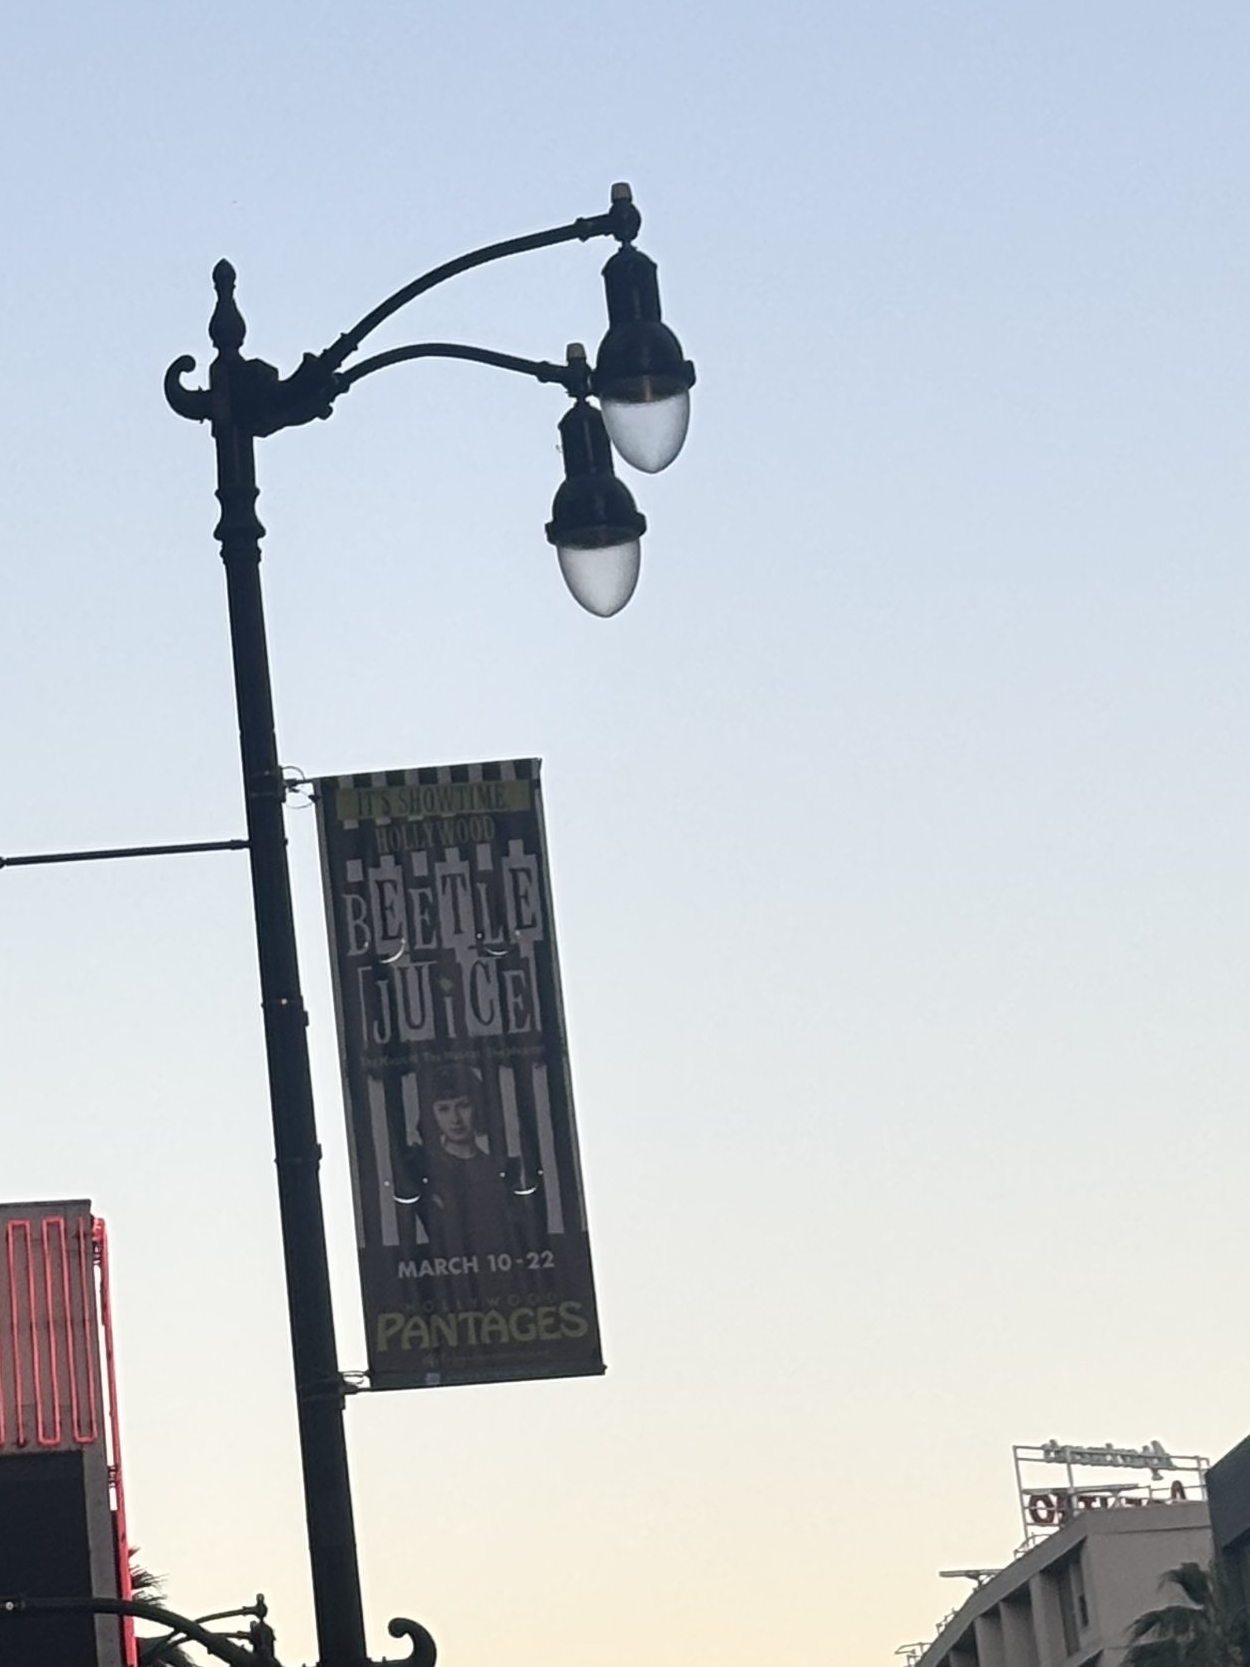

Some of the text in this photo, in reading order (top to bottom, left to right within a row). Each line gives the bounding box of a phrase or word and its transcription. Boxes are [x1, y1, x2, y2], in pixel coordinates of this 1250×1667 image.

[399, 783, 507, 814] SHOWTIME
[375, 815, 496, 854] HOLLYWOOD
[344, 867, 538, 956] BEETLE
[397, 1255, 480, 1280] MARCH
[405, 1291, 559, 1314] HOLLYWOOD
[376, 1299, 589, 1353] PANTAGES
